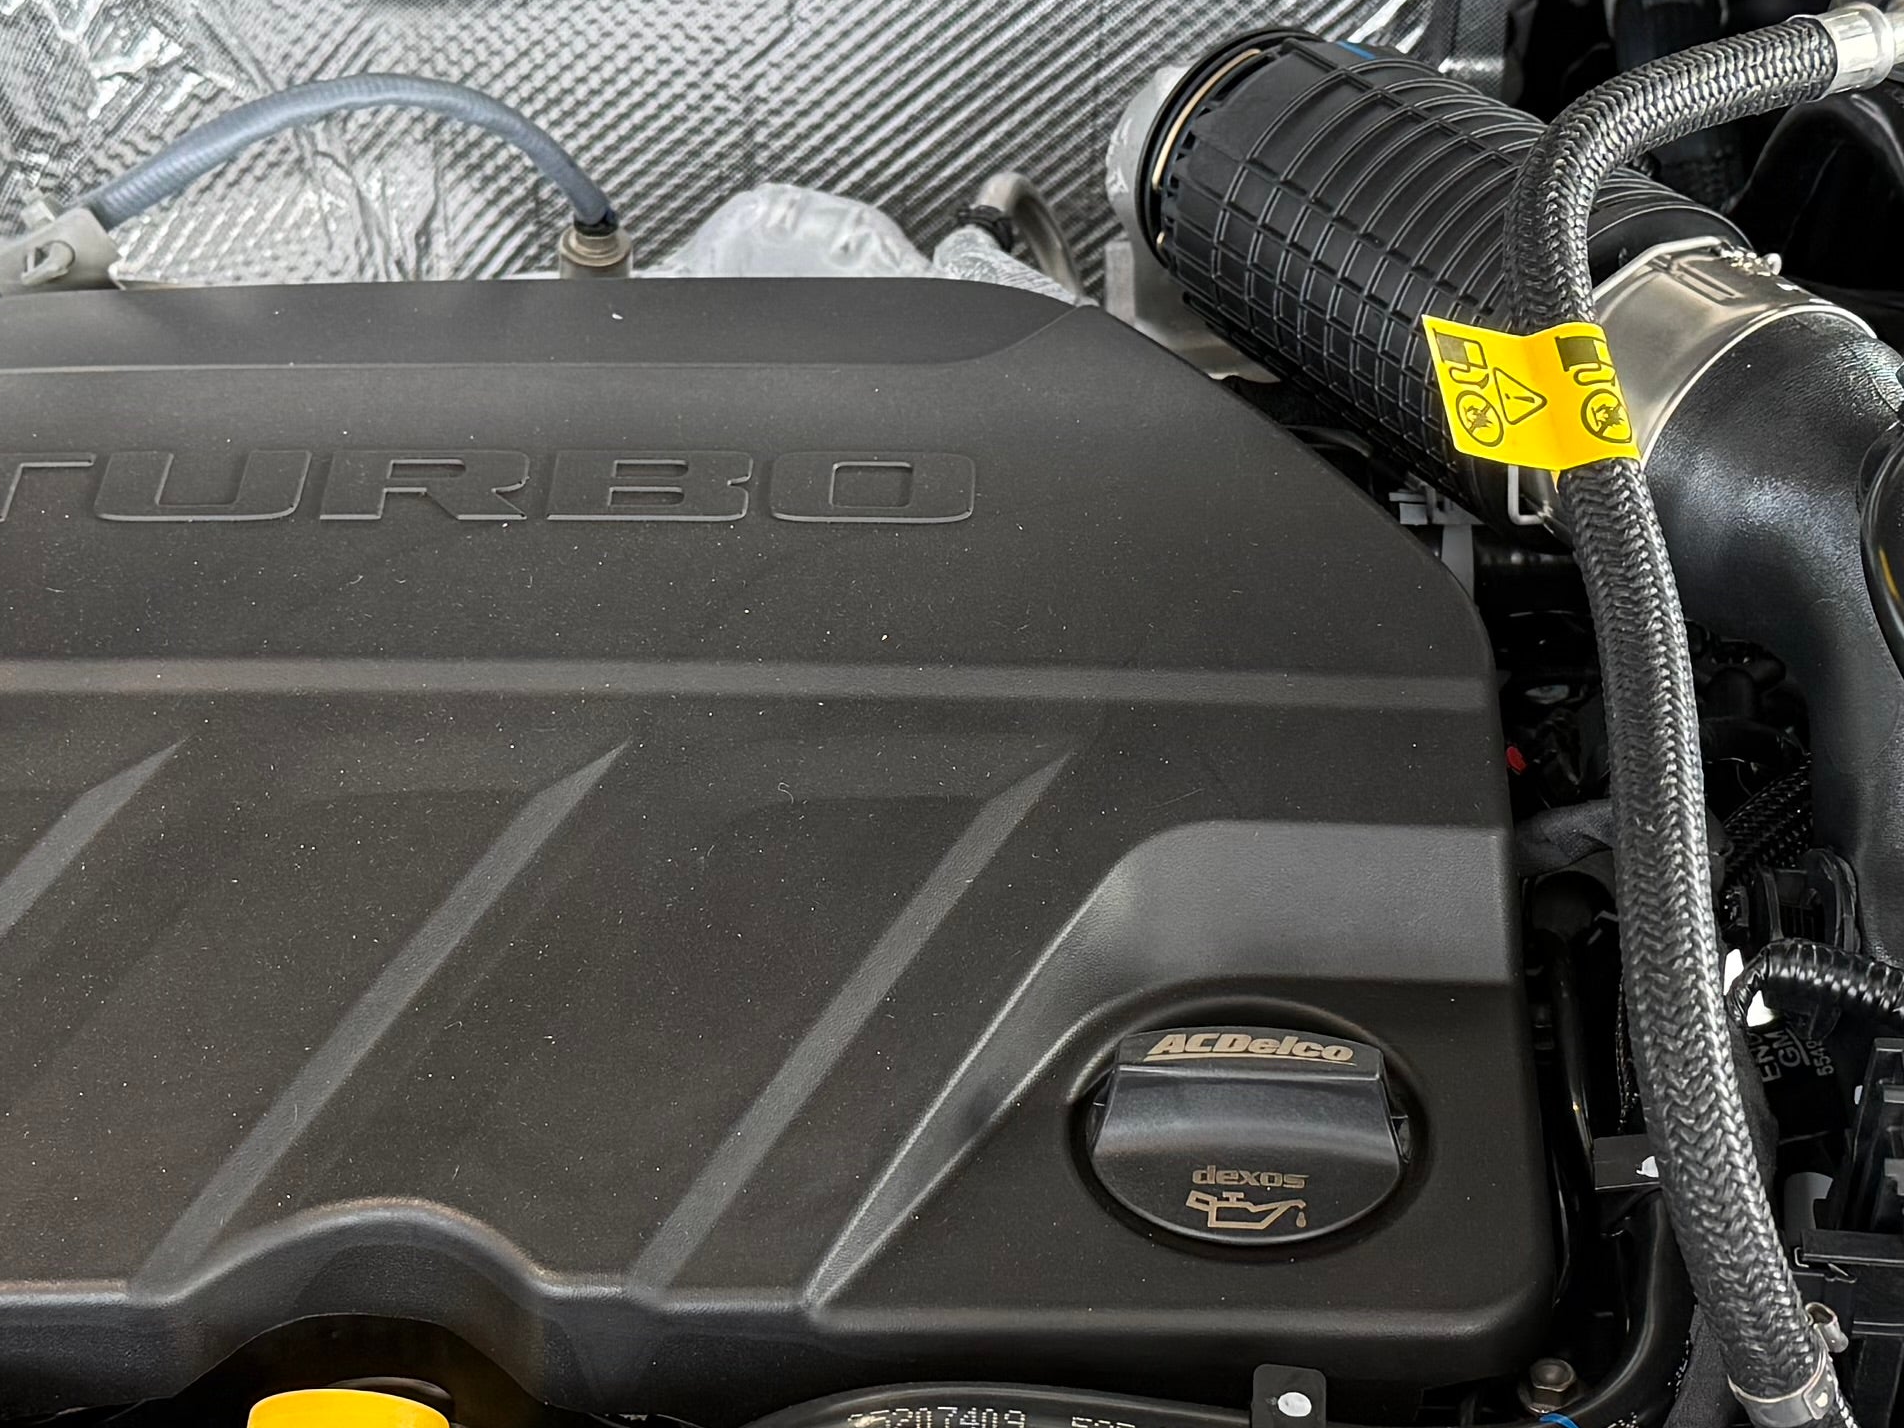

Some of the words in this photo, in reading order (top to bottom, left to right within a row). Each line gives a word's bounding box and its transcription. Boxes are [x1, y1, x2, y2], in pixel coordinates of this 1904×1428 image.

[1145, 1032, 1355, 1063] ACDelco
[1772, 1029, 1800, 1068] GM
[1192, 1164, 1309, 1189] dexos
